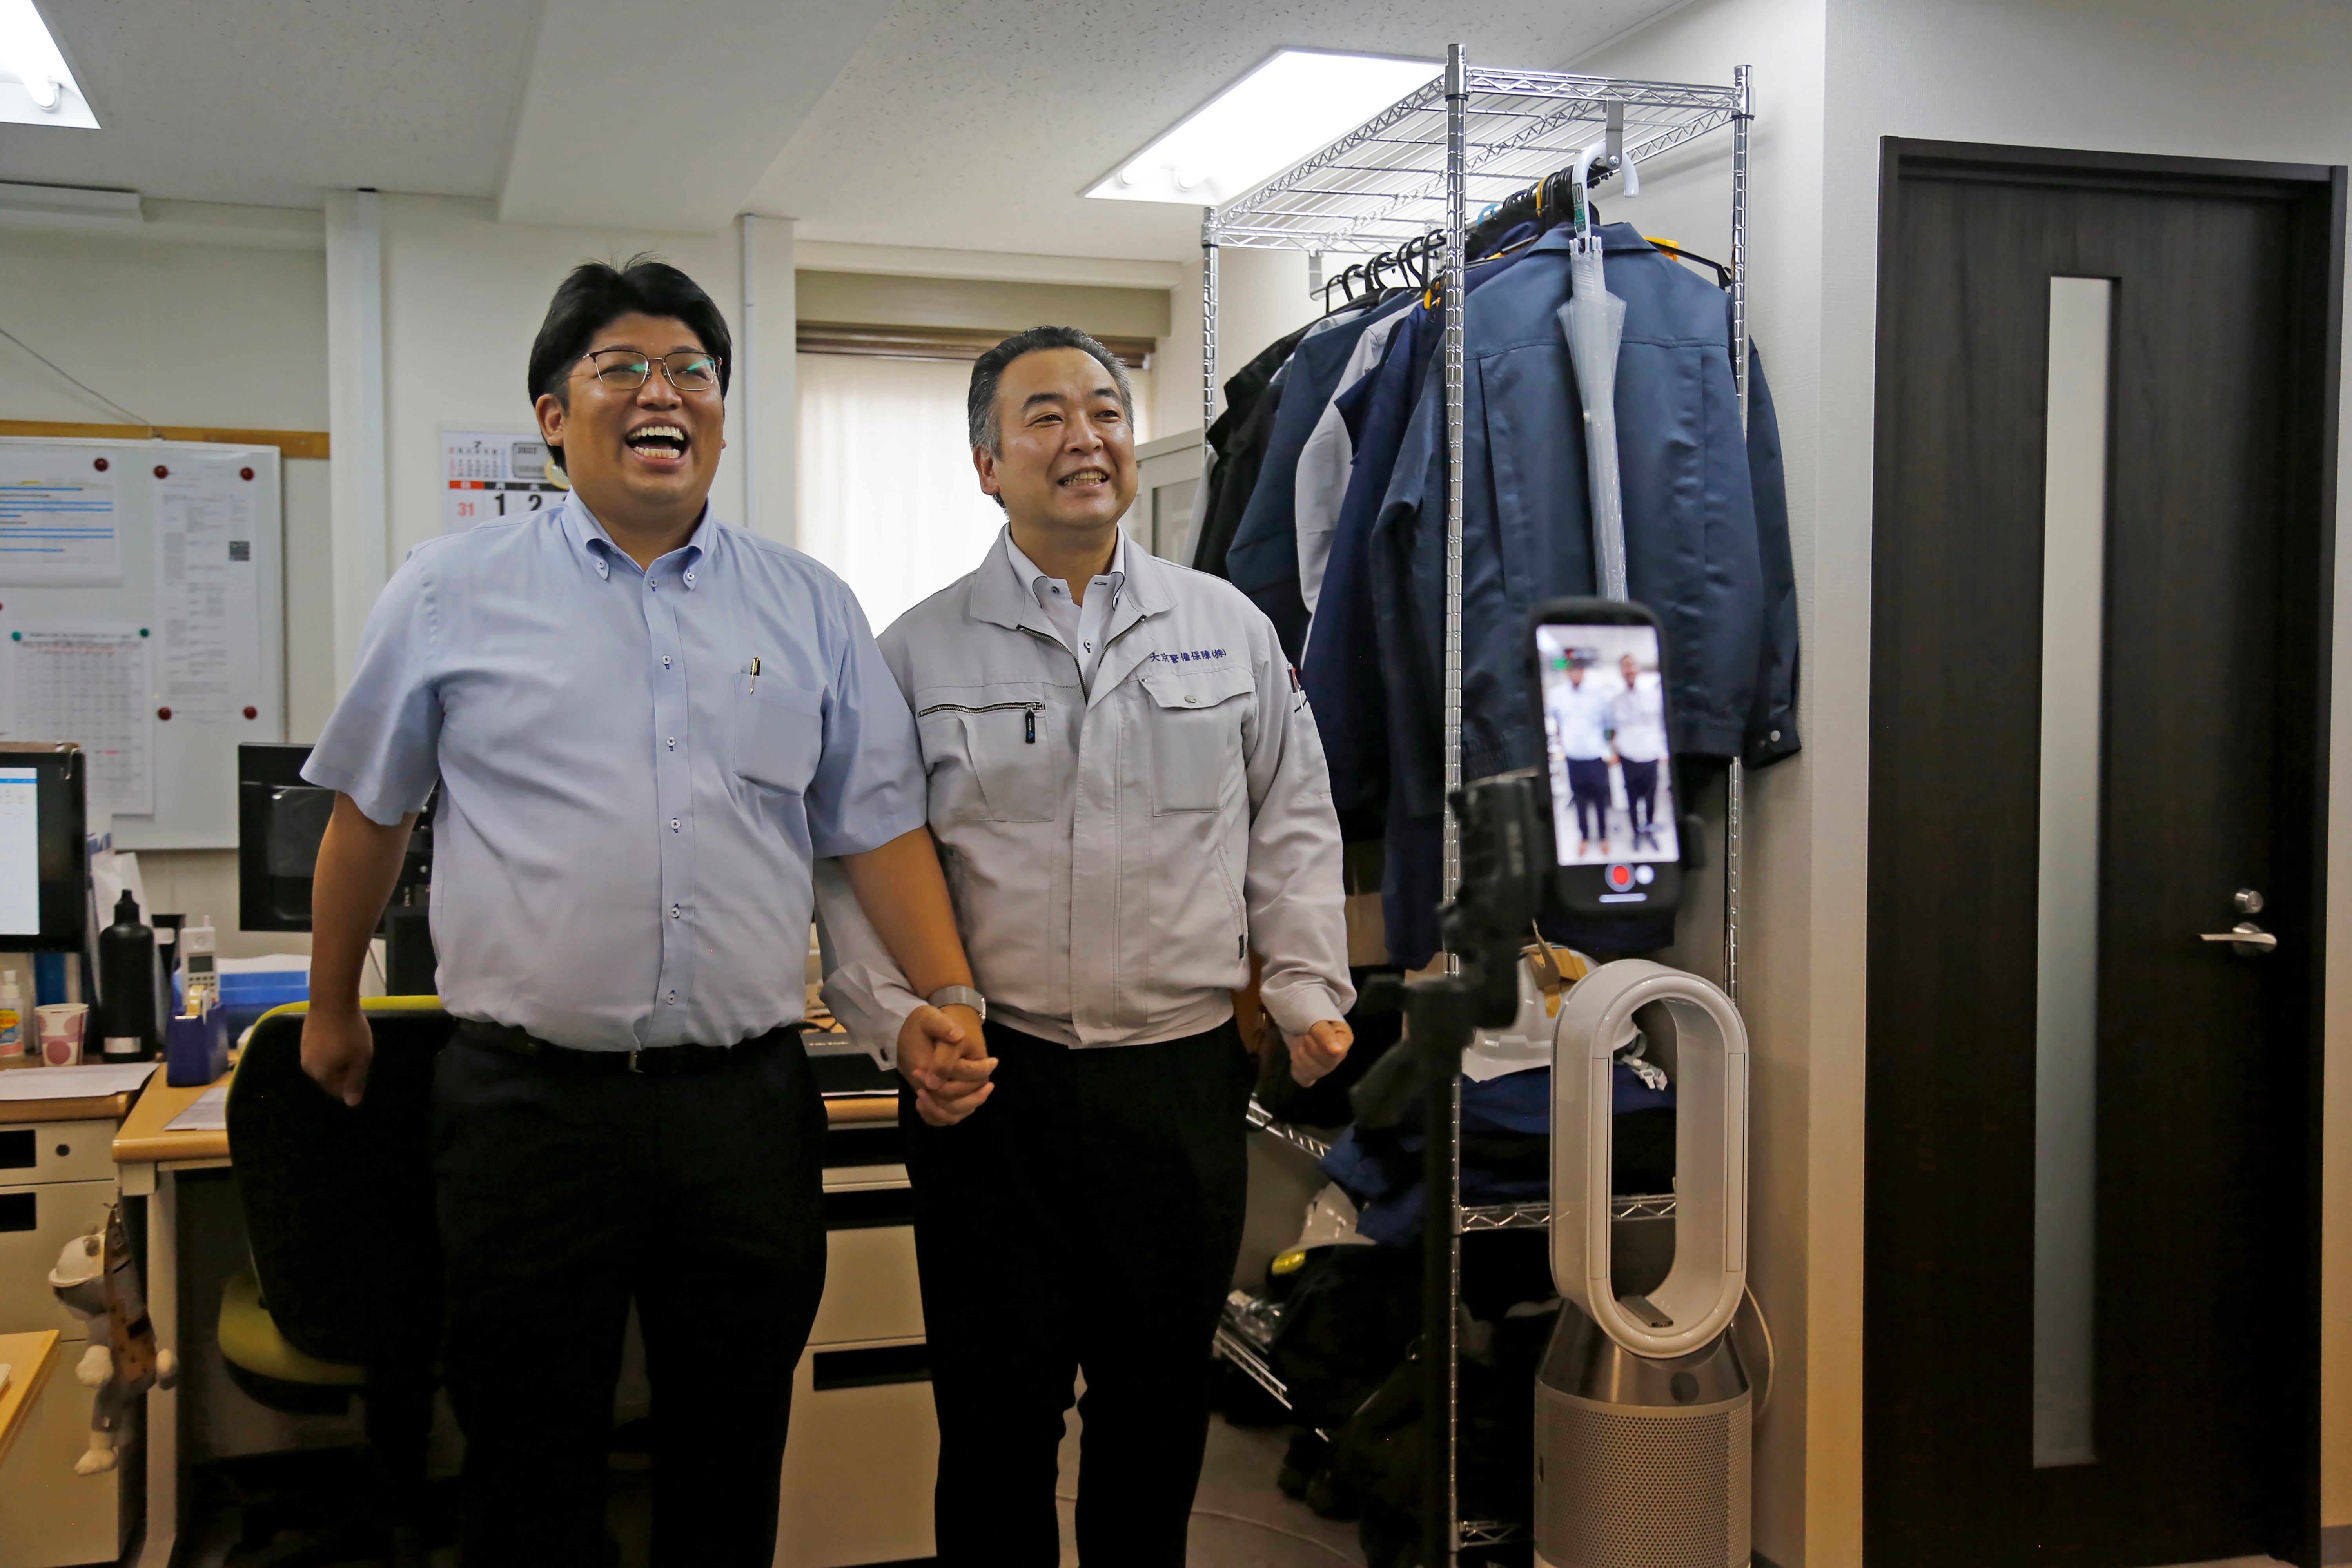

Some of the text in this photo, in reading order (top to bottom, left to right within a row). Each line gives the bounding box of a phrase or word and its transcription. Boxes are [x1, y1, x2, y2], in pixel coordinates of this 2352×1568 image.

[458, 494, 542, 516] 31 1 2
[1149, 648, 1226, 664] 大京警備保障(株)
